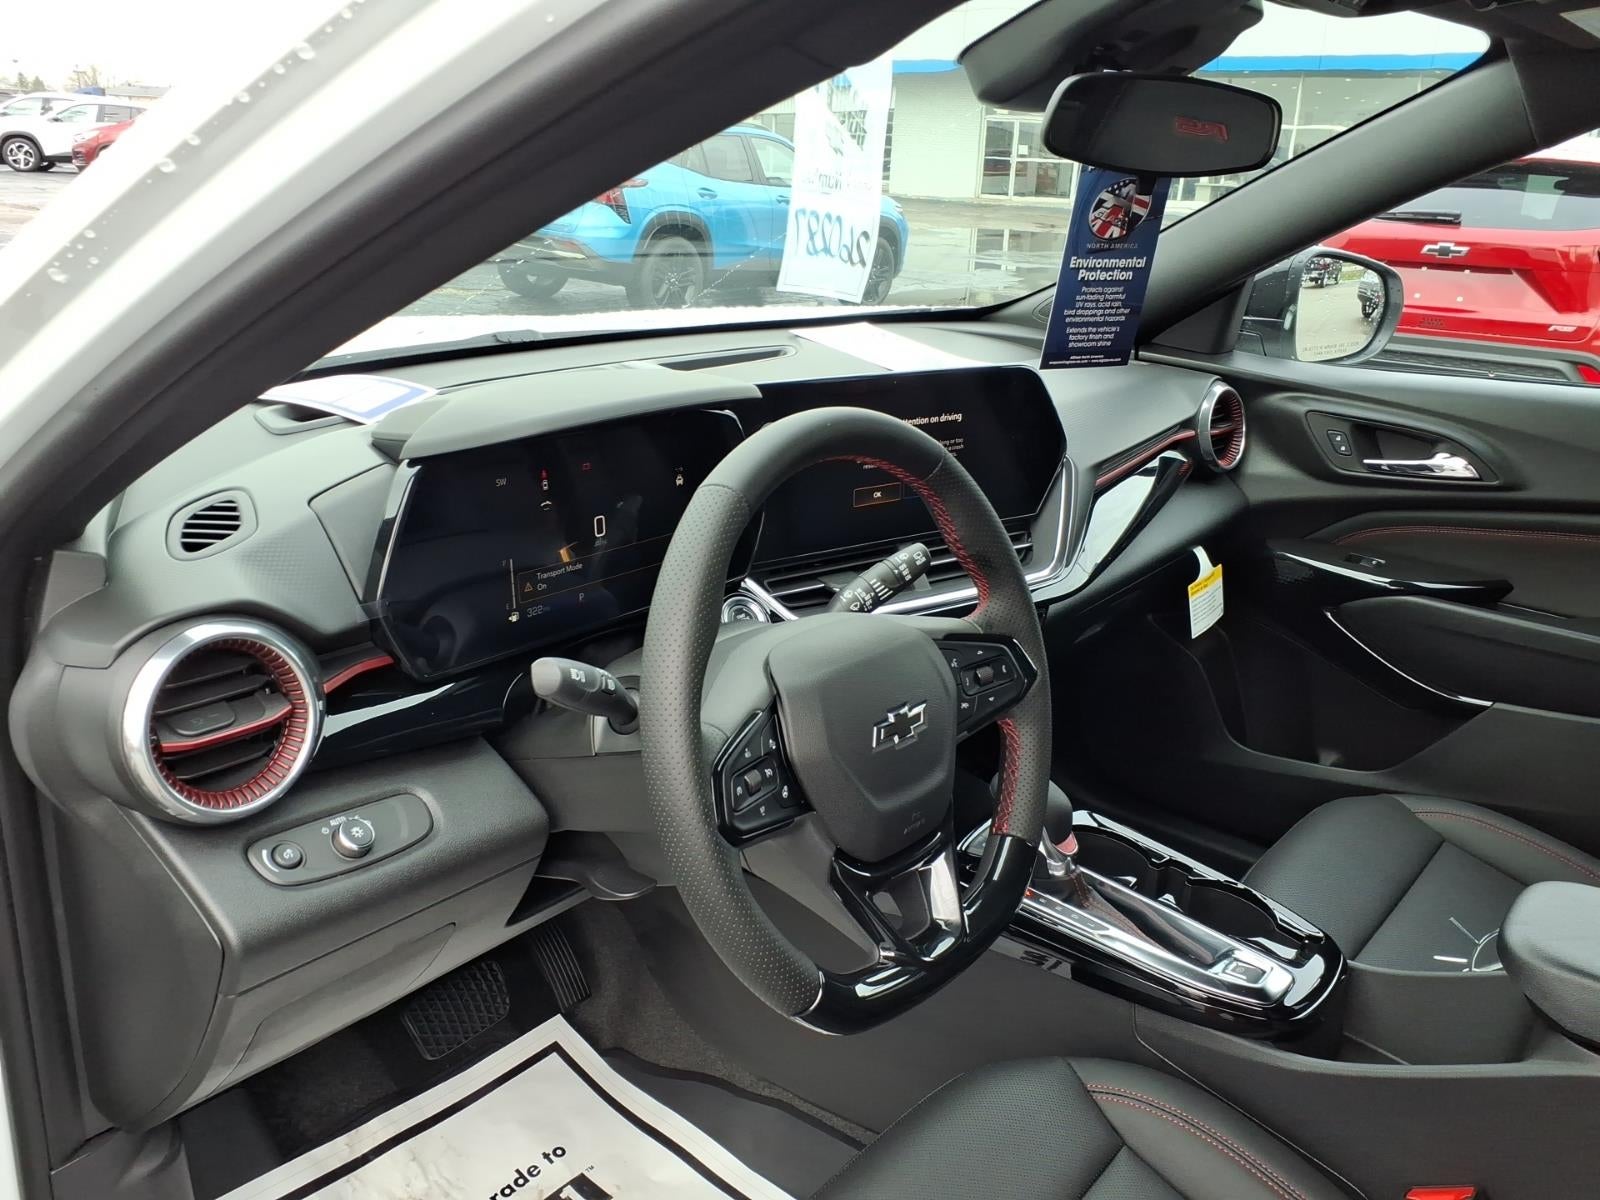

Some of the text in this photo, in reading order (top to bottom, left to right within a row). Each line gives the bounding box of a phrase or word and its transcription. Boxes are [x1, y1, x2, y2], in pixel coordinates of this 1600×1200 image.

[1069, 256, 1147, 268] Environmental
[1078, 269, 1133, 281] Protection
[1103, 286, 1125, 294] against
[940, 412, 962, 422] driving
[495, 477, 507, 487] SW
[594, 515, 606, 537] 0
[536, 562, 583, 580] Transport Mode
[537, 583, 547, 591] On
[579, 592, 585, 601] P
[527, 605, 543, 618] 322
[541, 1146, 566, 1164] to
[585, 1165, 595, 1173] TM
